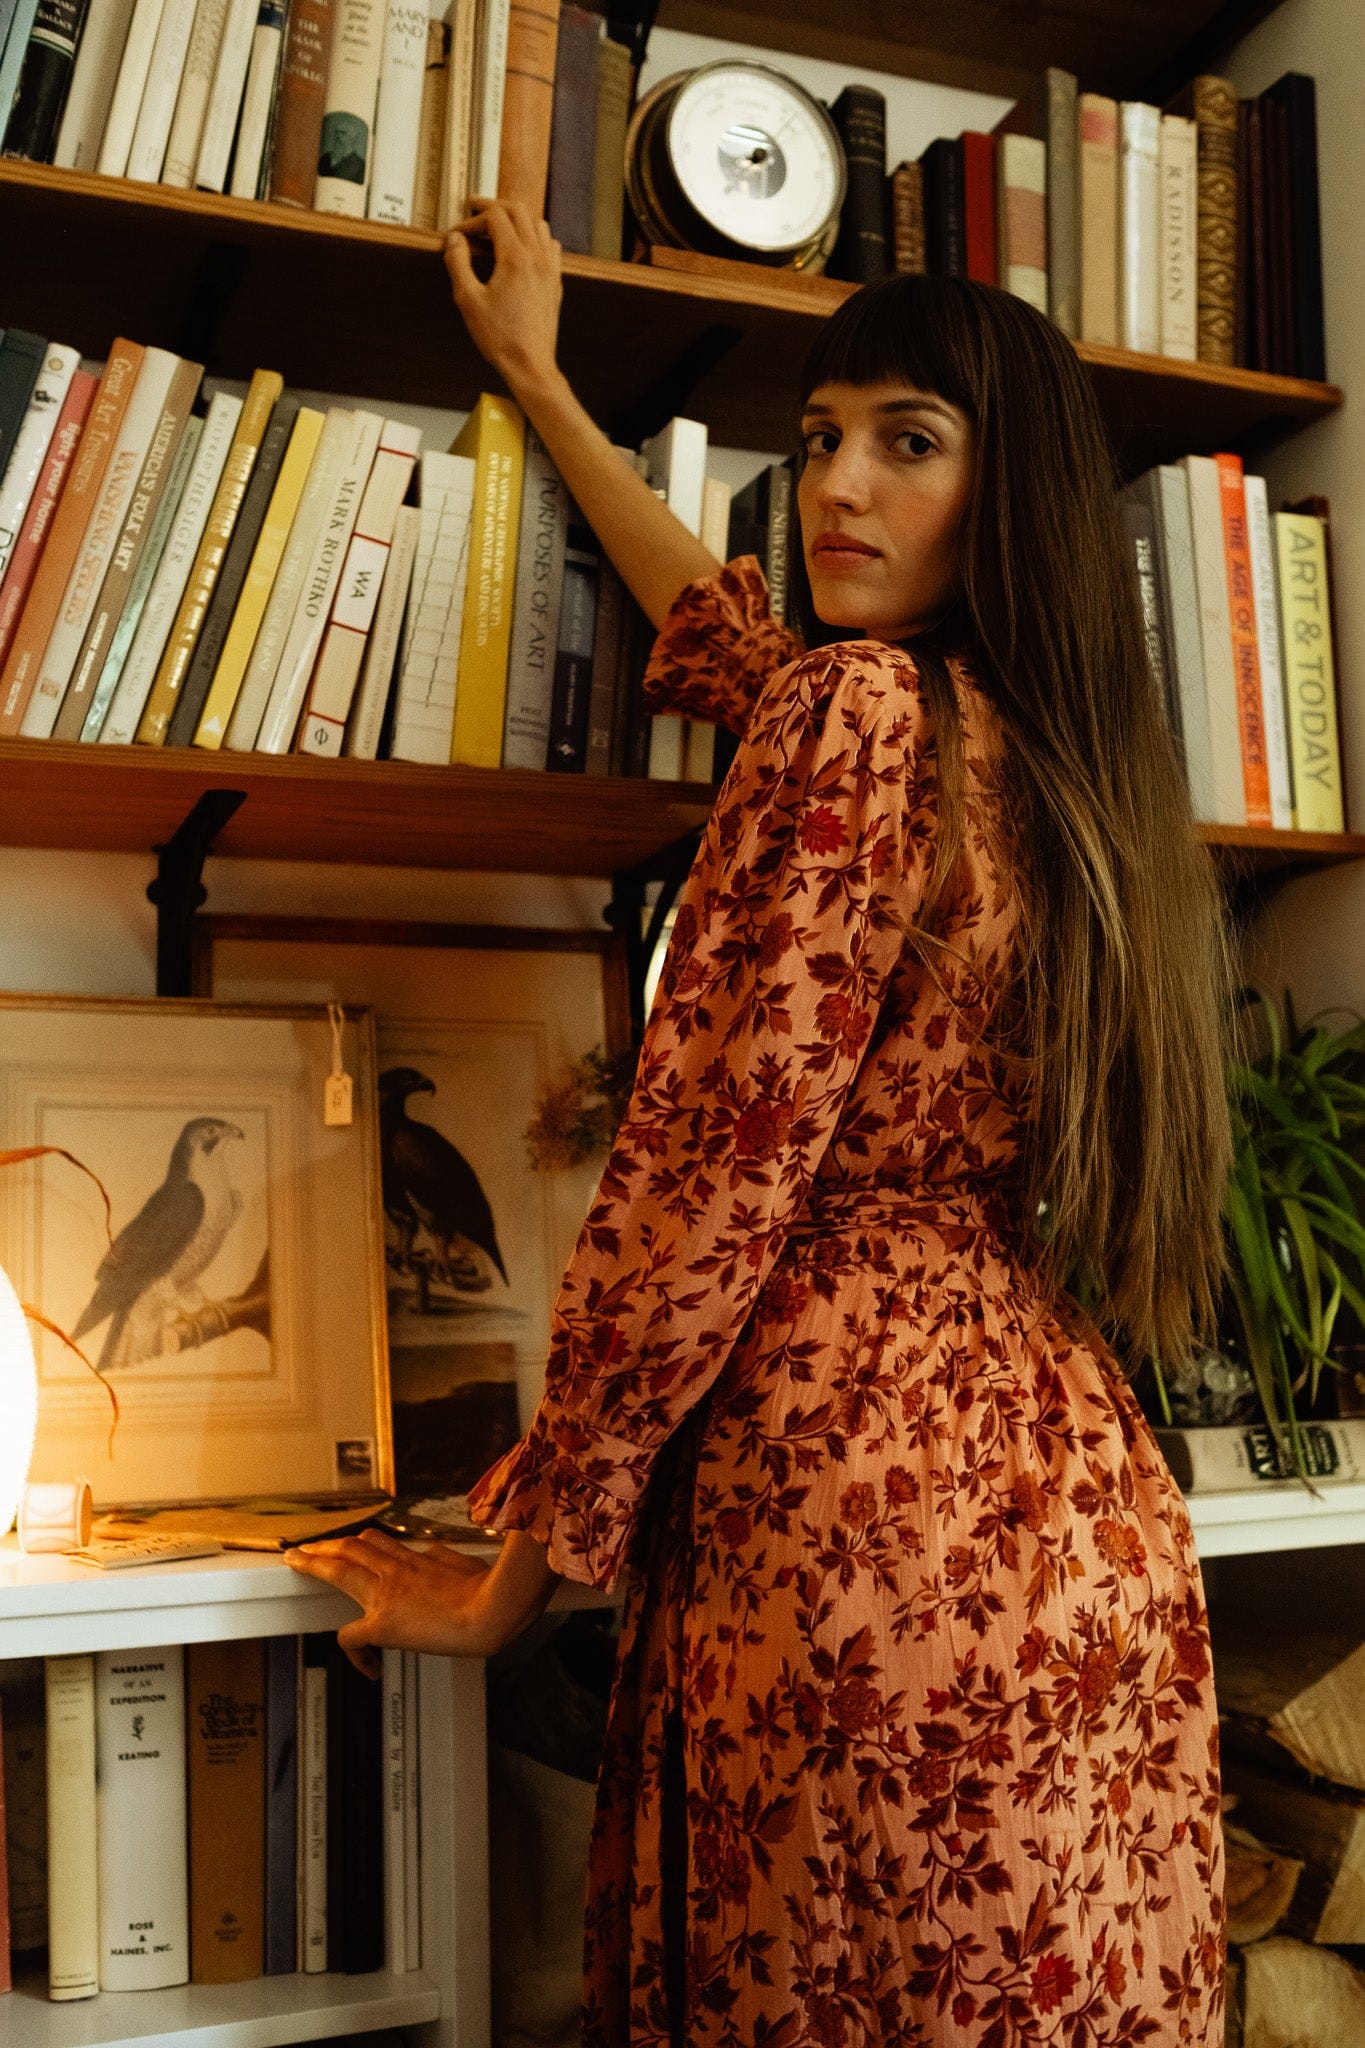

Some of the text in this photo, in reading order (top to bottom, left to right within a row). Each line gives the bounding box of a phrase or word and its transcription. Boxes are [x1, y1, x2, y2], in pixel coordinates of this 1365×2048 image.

[41, 458, 67, 496] your
[27, 497, 56, 545] home
[124, 492, 150, 532] FOLK
[167, 470, 210, 565] THESIGER
[326, 476, 358, 533] MARK
[111, 534, 136, 571] ART
[300, 536, 341, 619] ROTHKO
[350, 569, 373, 600] WA
[524, 476, 560, 674] PURPOSES OF ART
[1228, 515, 1262, 766] THE AGE OF INNOCENCE
[1286, 526, 1334, 792] ART & TODAY
[111, 1663, 165, 1674] NARRATIVE
[110, 1694, 167, 1705] EXPEDITION
[390, 1692, 402, 1736] Candide
[118, 1750, 160, 1761] KEATING
[390, 1748, 403, 1761] by
[129, 1922, 154, 1931] ROSS
[139, 1935, 146, 1943] &
